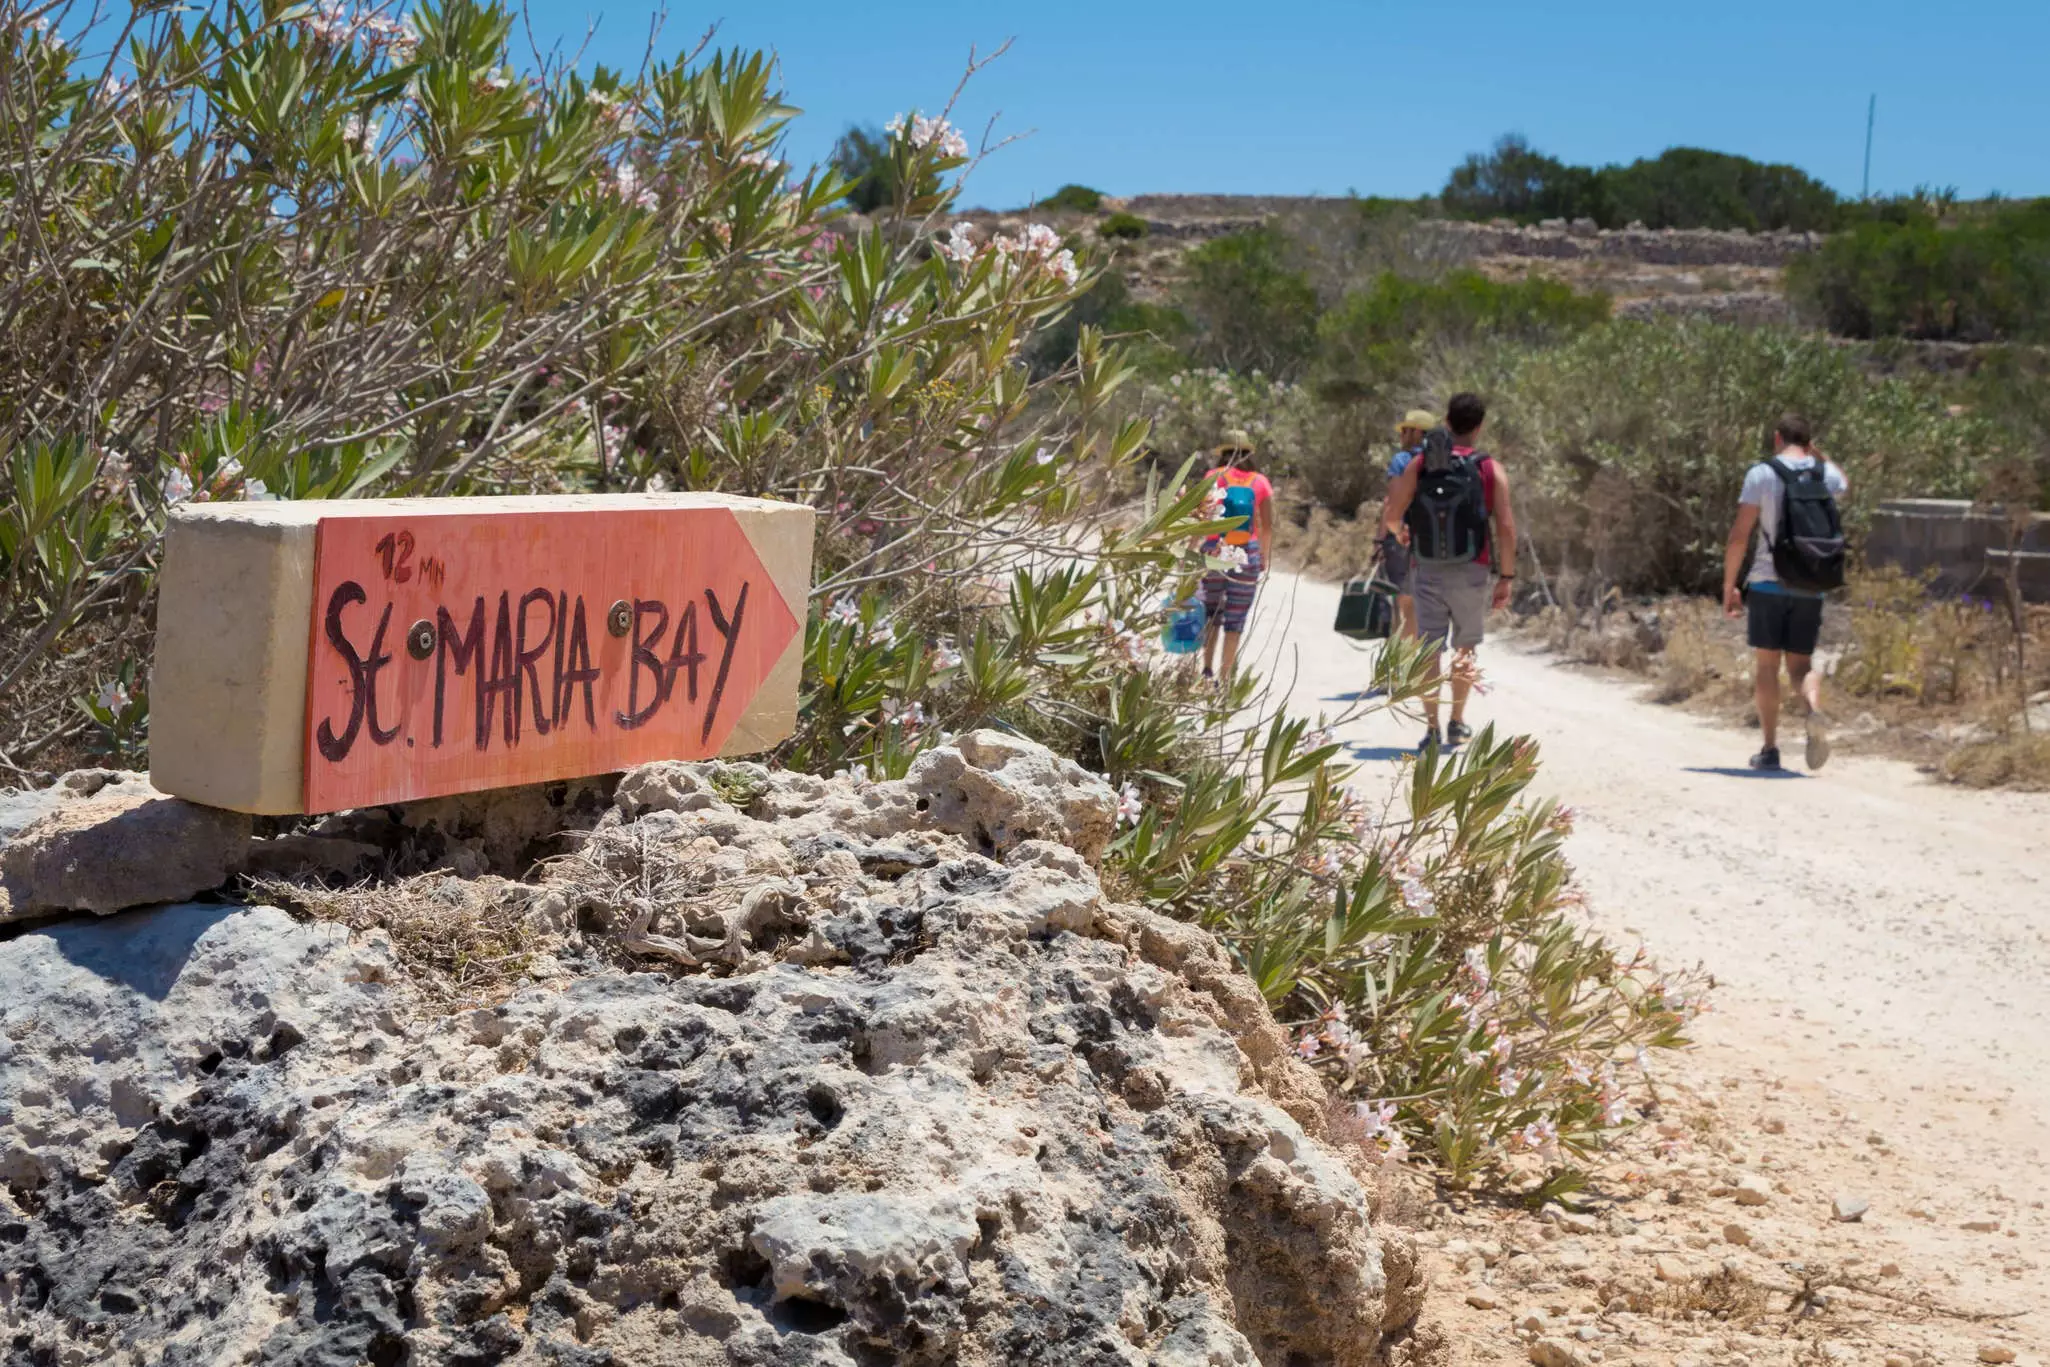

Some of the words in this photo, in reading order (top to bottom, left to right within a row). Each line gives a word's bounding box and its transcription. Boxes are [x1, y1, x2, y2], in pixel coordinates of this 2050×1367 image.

[375, 530, 415, 584] 12
[432, 587, 600, 751] MARIA
[615, 581, 748, 747] BAY
